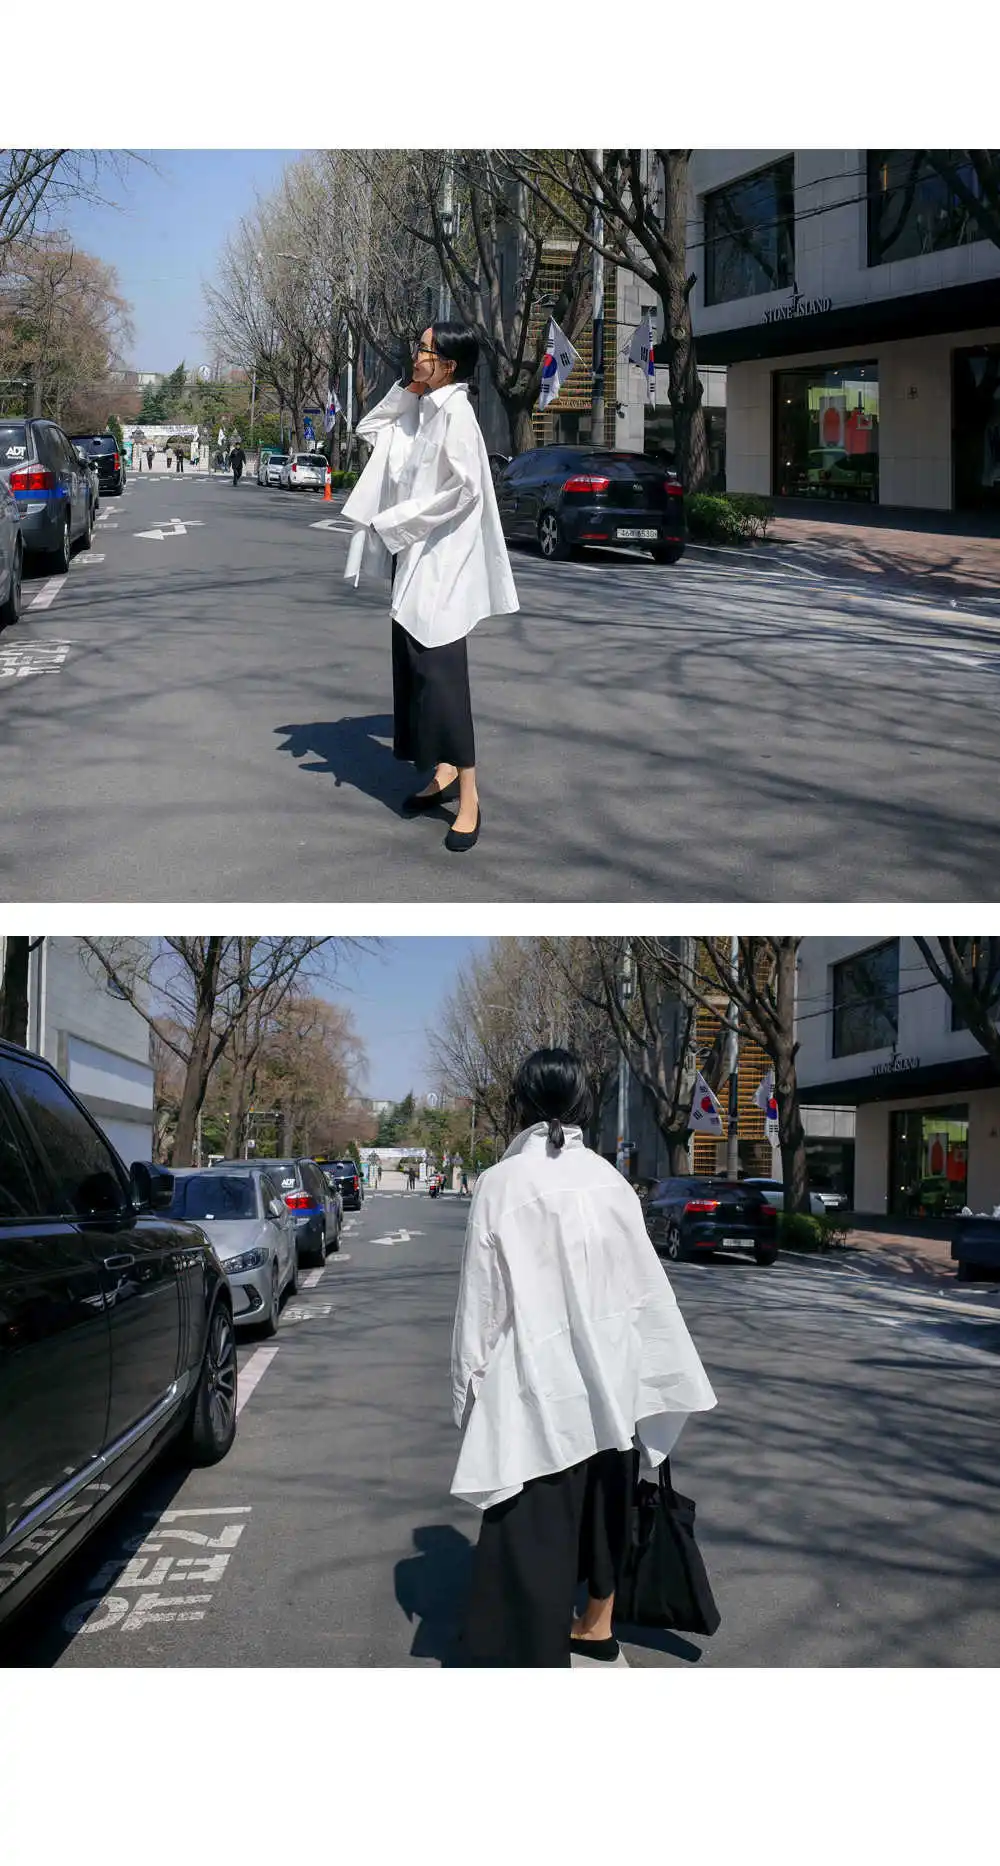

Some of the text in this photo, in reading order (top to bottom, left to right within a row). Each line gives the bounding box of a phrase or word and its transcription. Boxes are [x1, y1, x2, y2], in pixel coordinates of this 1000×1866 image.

[762, 297, 832, 324] STONE ISLAND
[5, 445, 27, 457] ADT
[281, 1178, 296, 1186] ADT
[62, 1506, 252, 1634] 유료21
